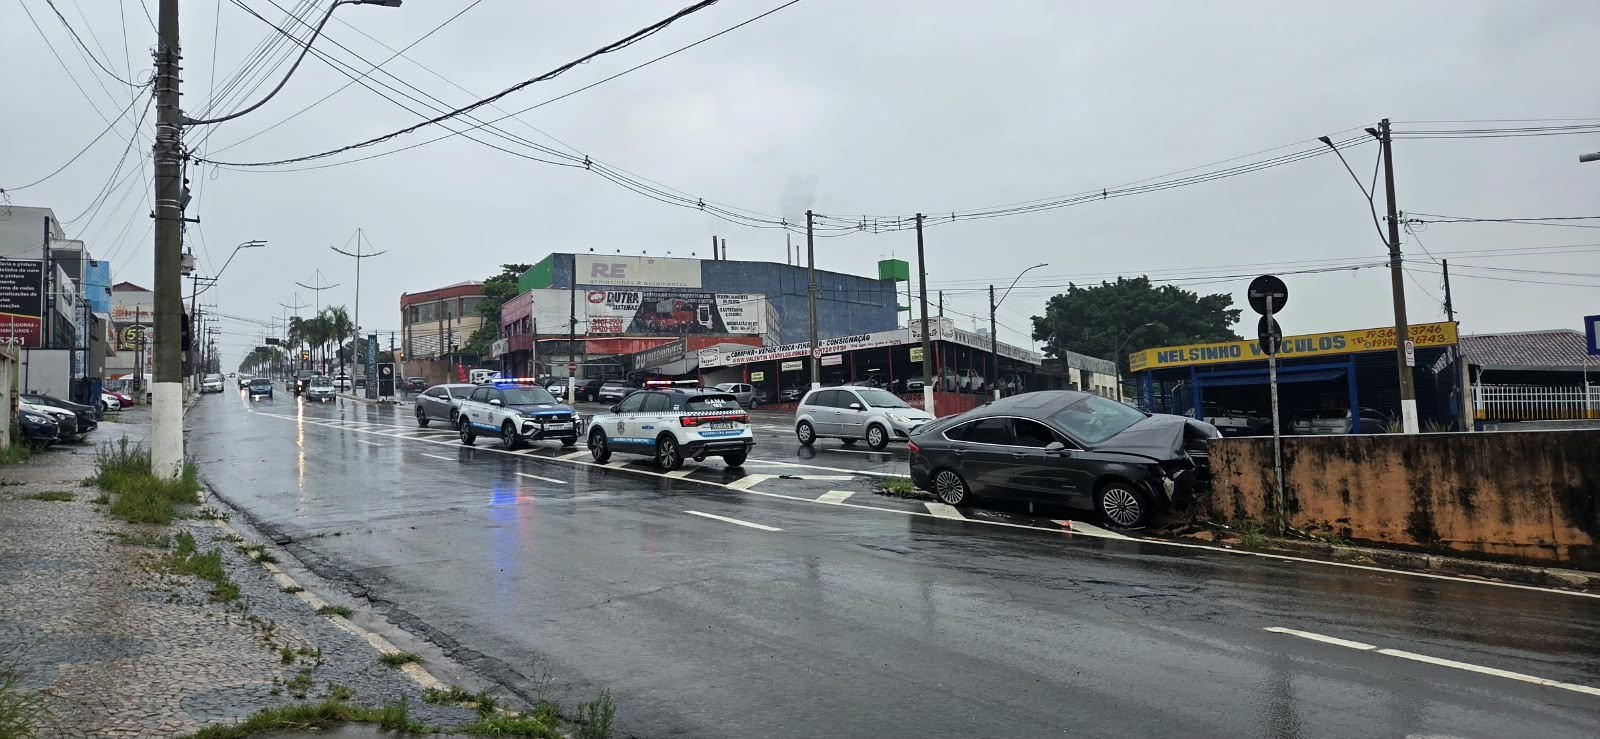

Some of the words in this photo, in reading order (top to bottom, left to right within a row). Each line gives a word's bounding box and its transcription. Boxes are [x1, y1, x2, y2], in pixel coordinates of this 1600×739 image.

[590, 262, 627, 279] RE
[607, 291, 640, 304] DUTRA
[731, 349, 755, 358] COMPRA
[826, 334, 871, 346] CONSIGNAÇÃO
[1157, 345, 1242, 364] NELSINHO
[1250, 335, 1347, 356] VCULOS
[635, 353, 646, 370] DU
